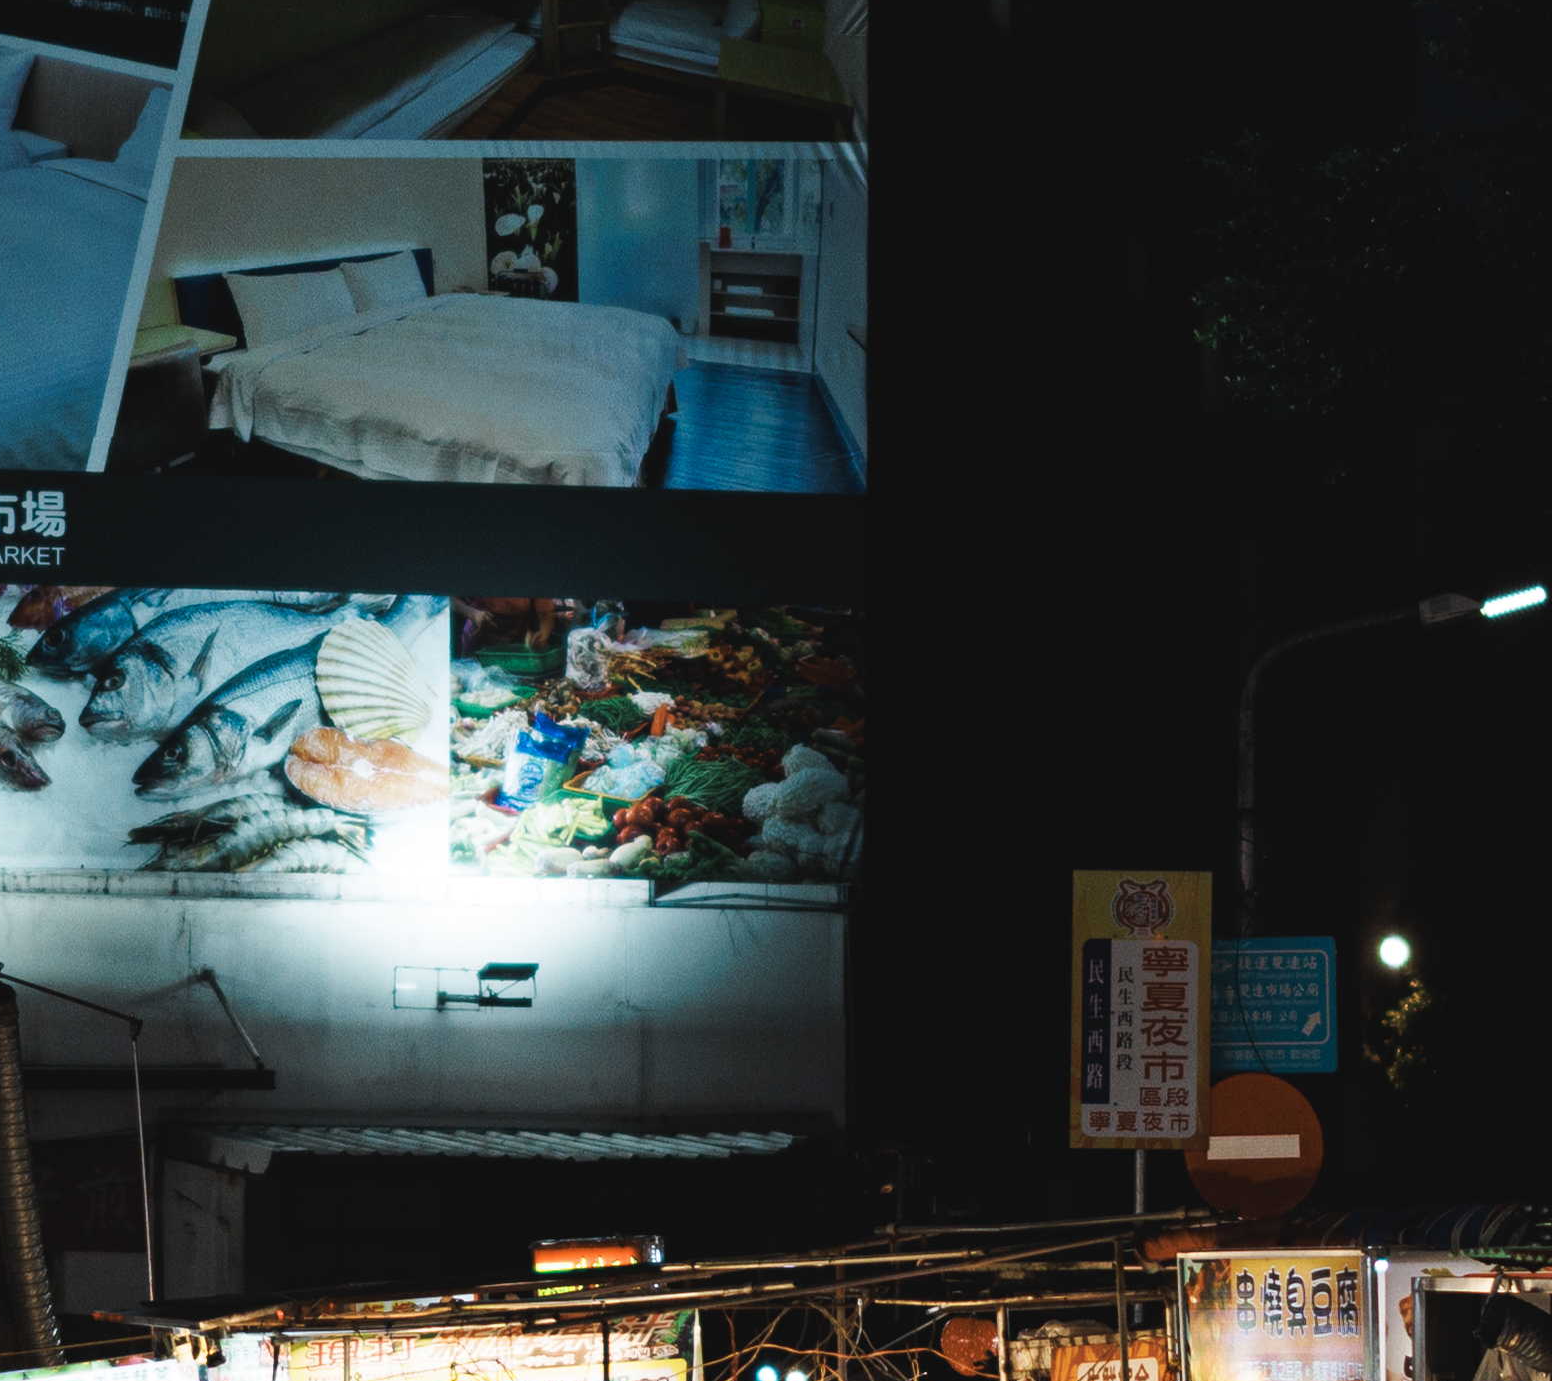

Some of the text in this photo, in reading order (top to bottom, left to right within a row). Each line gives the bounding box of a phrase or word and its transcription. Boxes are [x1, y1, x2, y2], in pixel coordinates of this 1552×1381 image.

[1086, 958, 1105, 1090] 民生西路
[1115, 965, 1135, 1072] 民生西路段
[1139, 945, 1190, 1084] 寧夏夜市
[1089, 1111, 1191, 1133] 寧夏夜市
[1235, 1266, 1360, 1339] 串燒臭豆腐
